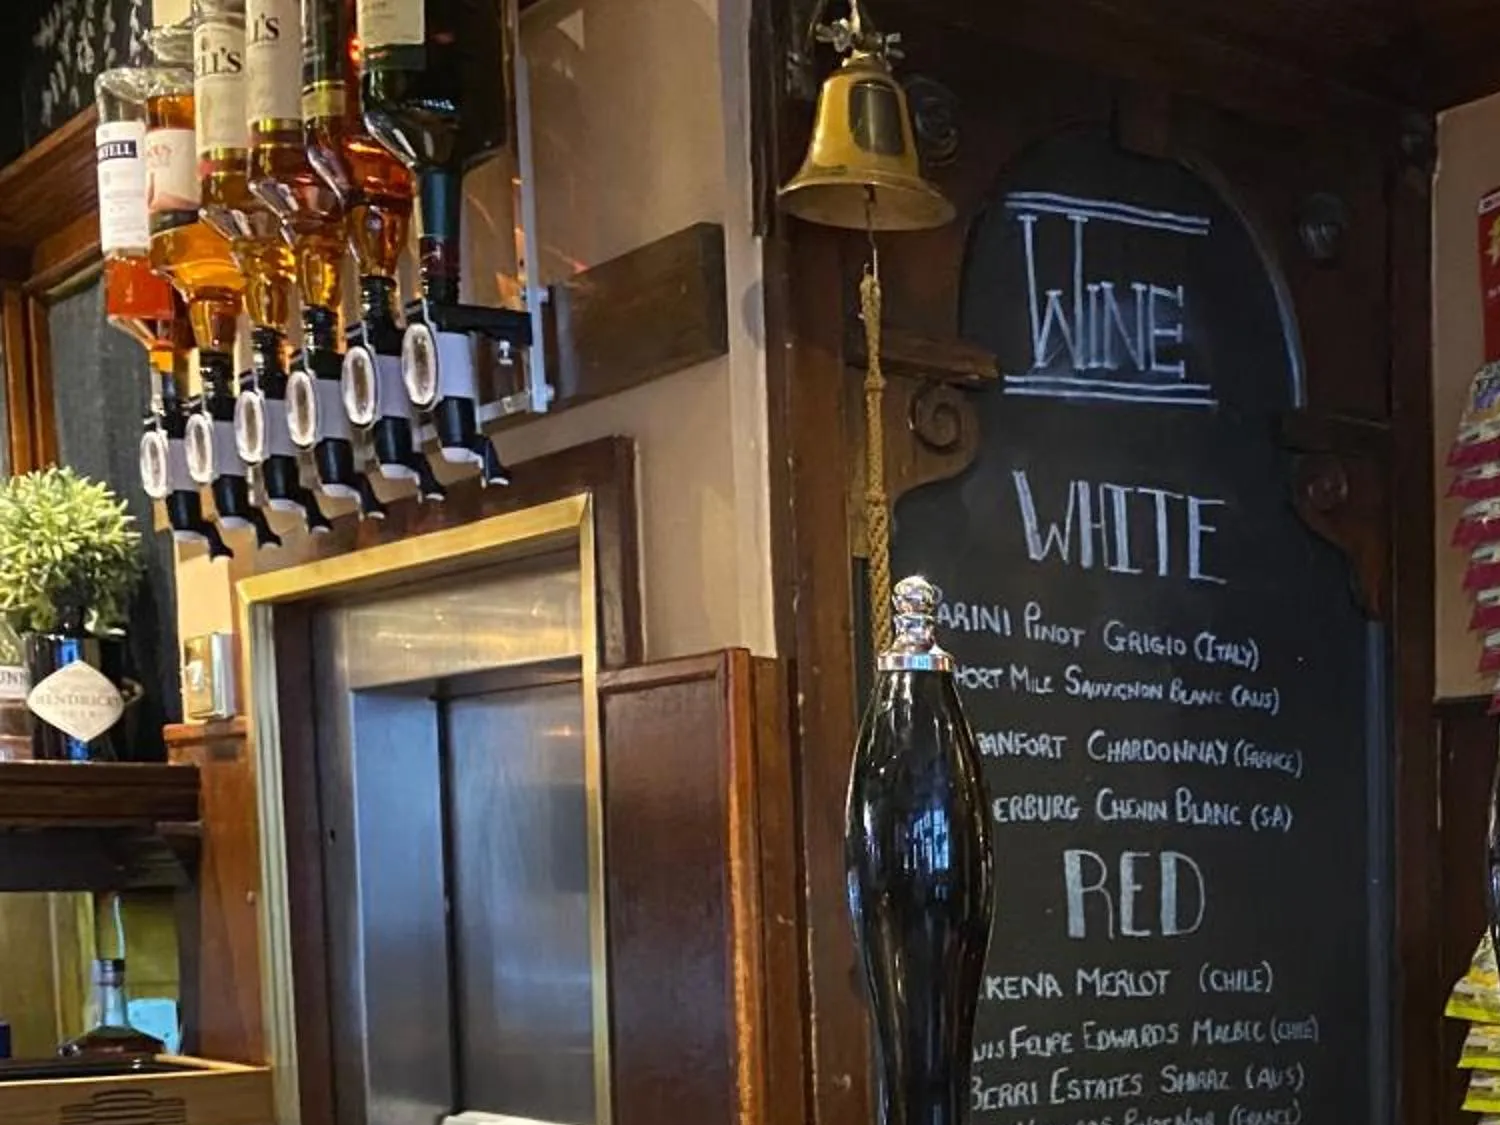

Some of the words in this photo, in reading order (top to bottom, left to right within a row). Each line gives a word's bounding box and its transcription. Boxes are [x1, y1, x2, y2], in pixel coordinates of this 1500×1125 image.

[1017, 214, 1186, 378] WINE
[1011, 469, 1228, 585] WHITE
[937, 601, 1012, 638] ARINI
[952, 663, 1004, 690] HORT
[1086, 729, 1230, 767] CHARDONNAY
[991, 793, 1081, 823] ERBURG
[1063, 848, 1206, 940] RED
[978, 972, 1063, 1001] KENA
[1076, 967, 1172, 998] MERLOT
[972, 1037, 1005, 1063] UIS
[1082, 1020, 1180, 1051] EDWARDS
[1049, 1066, 1144, 1105] ESTATES
